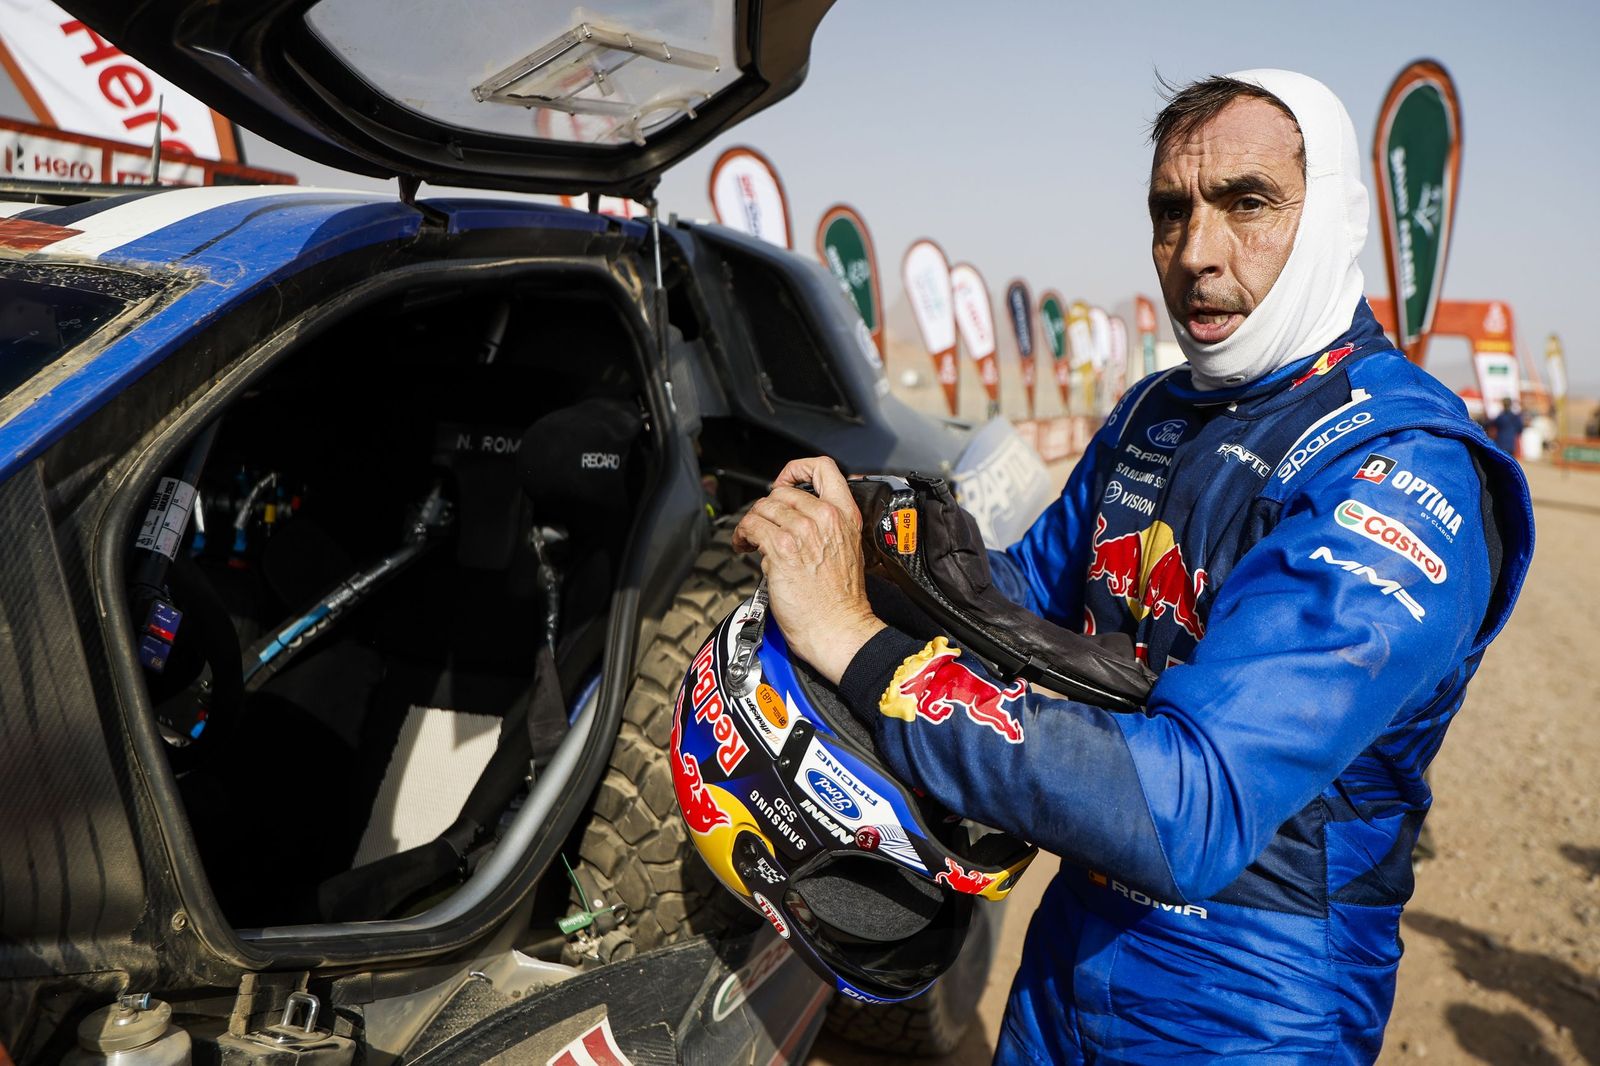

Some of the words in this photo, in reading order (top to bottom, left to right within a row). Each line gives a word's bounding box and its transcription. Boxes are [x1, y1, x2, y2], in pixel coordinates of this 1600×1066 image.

[34, 154, 94, 180] Hero
[457, 434, 473, 450] N.
[482, 436, 522, 453] ROM
[1125, 444, 1172, 466] RACIN
[1277, 412, 1375, 485] sparco
[582, 452, 620, 469] RECARO
[1216, 442, 1272, 479] RAPTO
[1121, 491, 1156, 516] VISION
[1391, 470, 1463, 536] OPTIMA
[1420, 512, 1430, 520] BY
[1431, 519, 1454, 543] CLARIOS
[1364, 516, 1442, 579] Castrol
[759, 687, 772, 704] 481
[815, 749, 877, 807] RACING
[815, 777, 853, 812] Ford
[750, 789, 807, 851] SAMSUNG
[774, 797, 797, 823] SSD
[799, 799, 855, 845] NANI
[1111, 880, 1208, 919] ROMA
[760, 901, 785, 933] BELL
